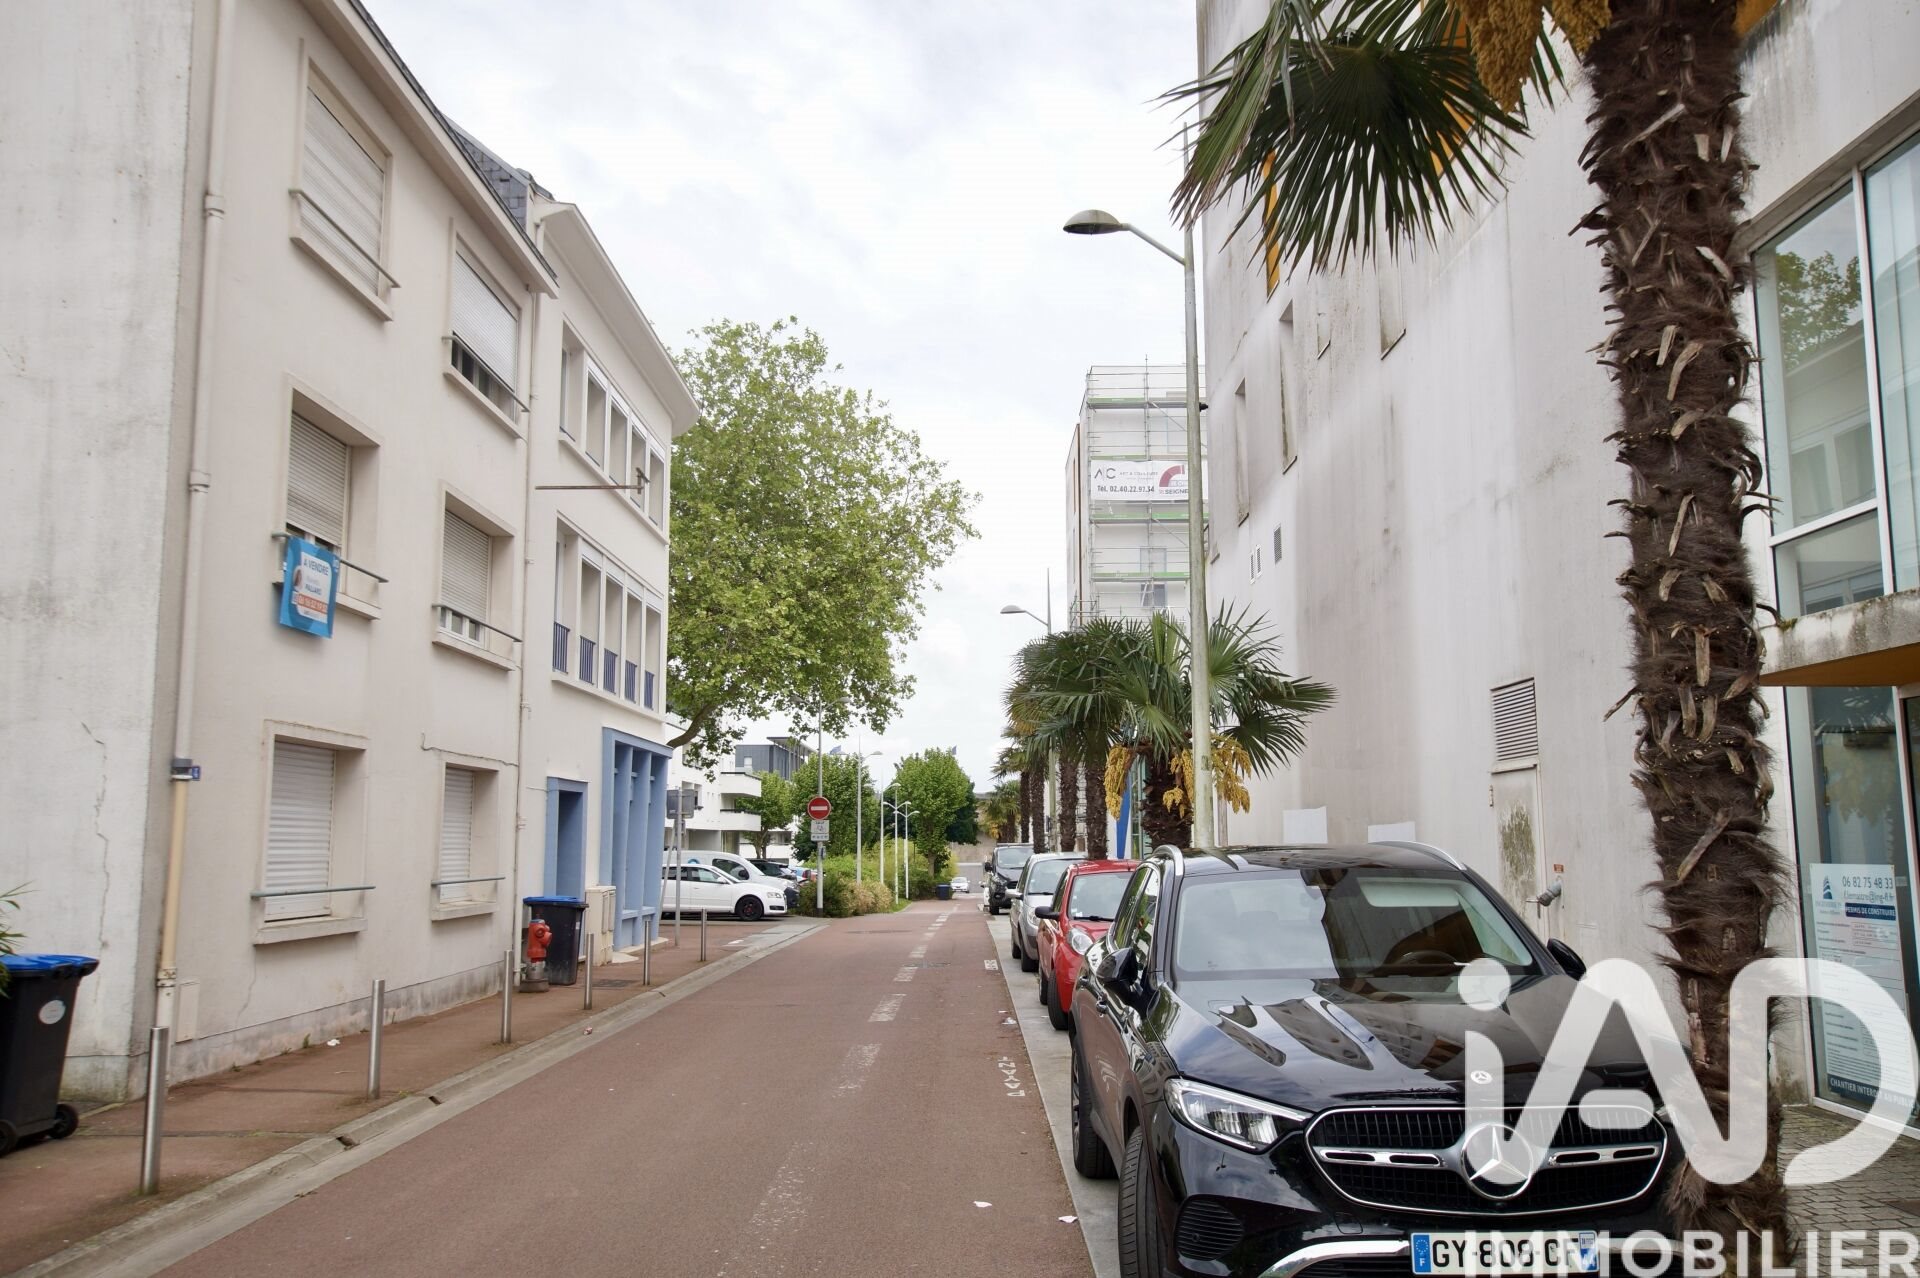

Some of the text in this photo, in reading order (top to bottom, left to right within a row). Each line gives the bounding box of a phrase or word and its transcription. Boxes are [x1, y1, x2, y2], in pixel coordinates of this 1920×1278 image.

[308, 559, 329, 576] VENDRE
[1842, 875, 1894, 890] 06 82 75 48 33
[1846, 906, 1861, 914] PERMIS
[1867, 907, 1896, 917] CONSTRUIRE
[1830, 1077, 1857, 1093] CHANTIER
